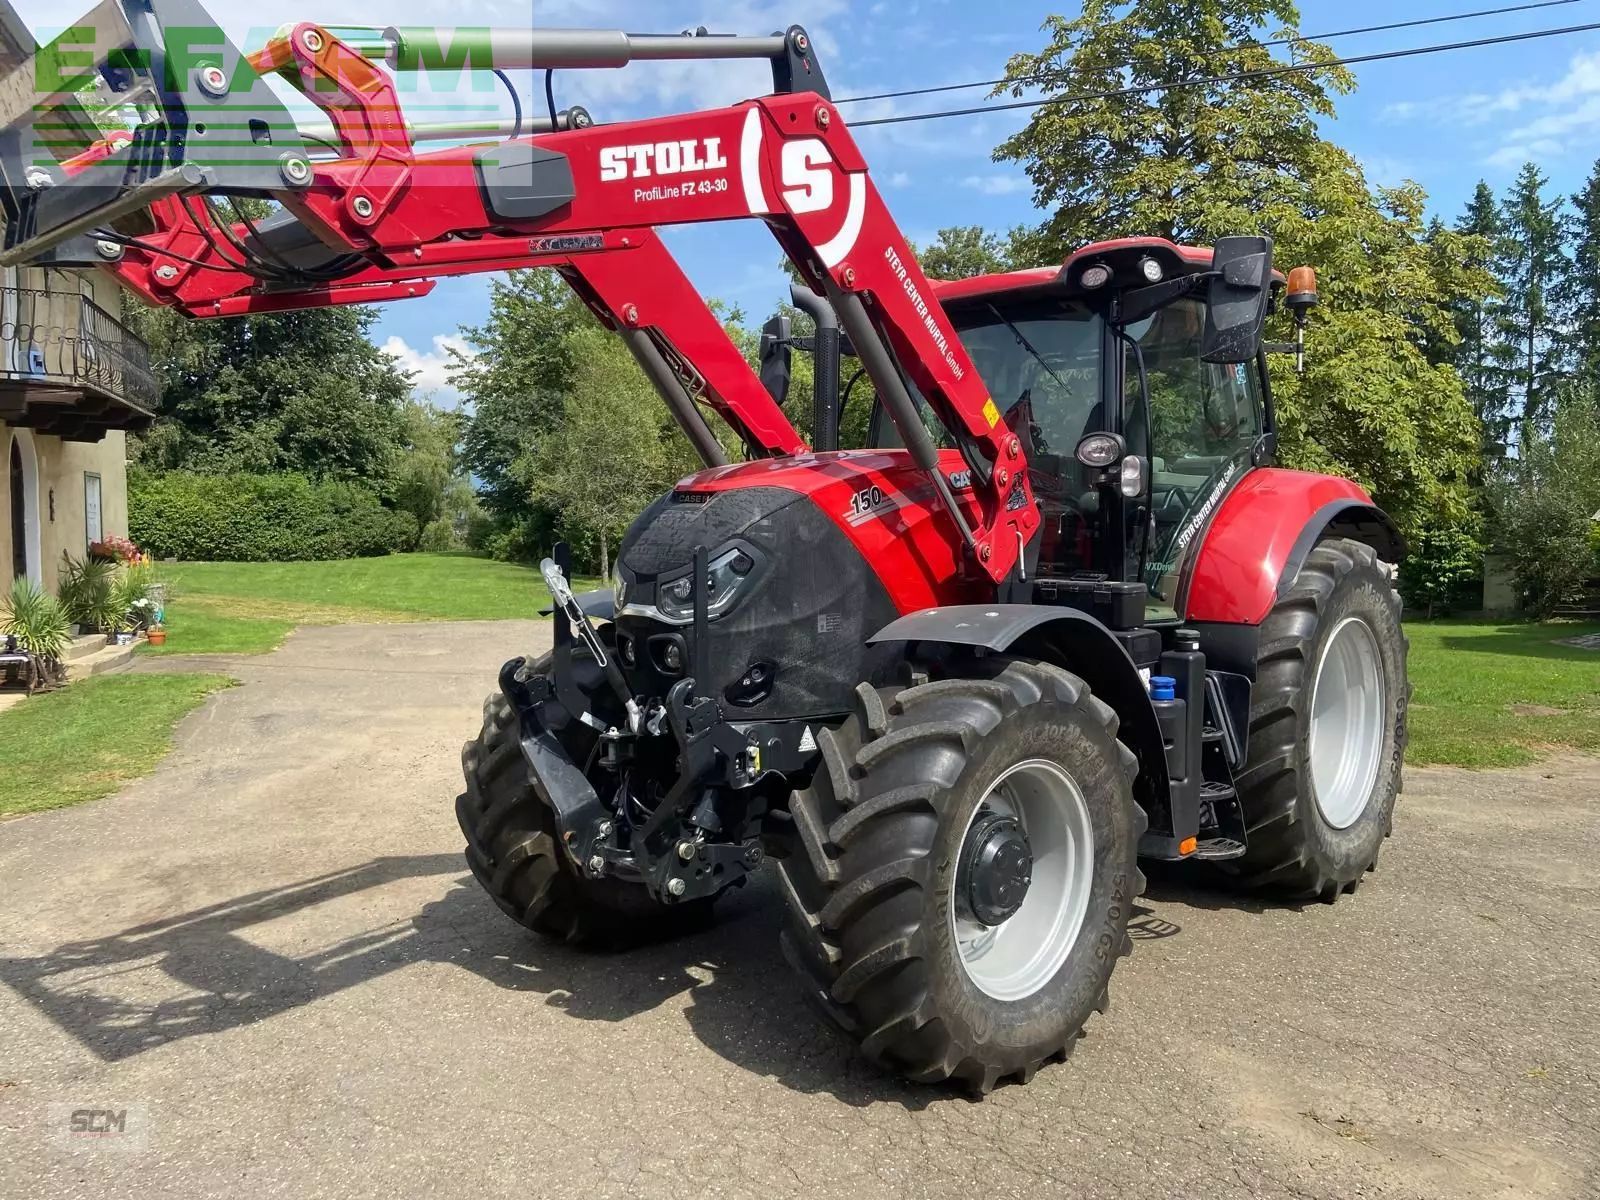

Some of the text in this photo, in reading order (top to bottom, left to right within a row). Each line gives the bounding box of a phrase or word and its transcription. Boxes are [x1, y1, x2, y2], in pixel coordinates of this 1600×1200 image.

[599, 137, 728, 182] STOLL
[780, 138, 833, 215] S
[634, 178, 728, 203] ProfiLine FZ 43-30
[884, 246, 965, 381] STEYR CENTER MURTAL GmbH
[679, 495, 702, 503] CASE
[850, 485, 883, 516] 150
[1178, 523, 1196, 548] STEYR
[1193, 500, 1212, 529] CENTER
[1209, 477, 1227, 506] MURTAL
[1144, 562, 1176, 571] VXDrive
[1094, 872, 1127, 964] 540/65
